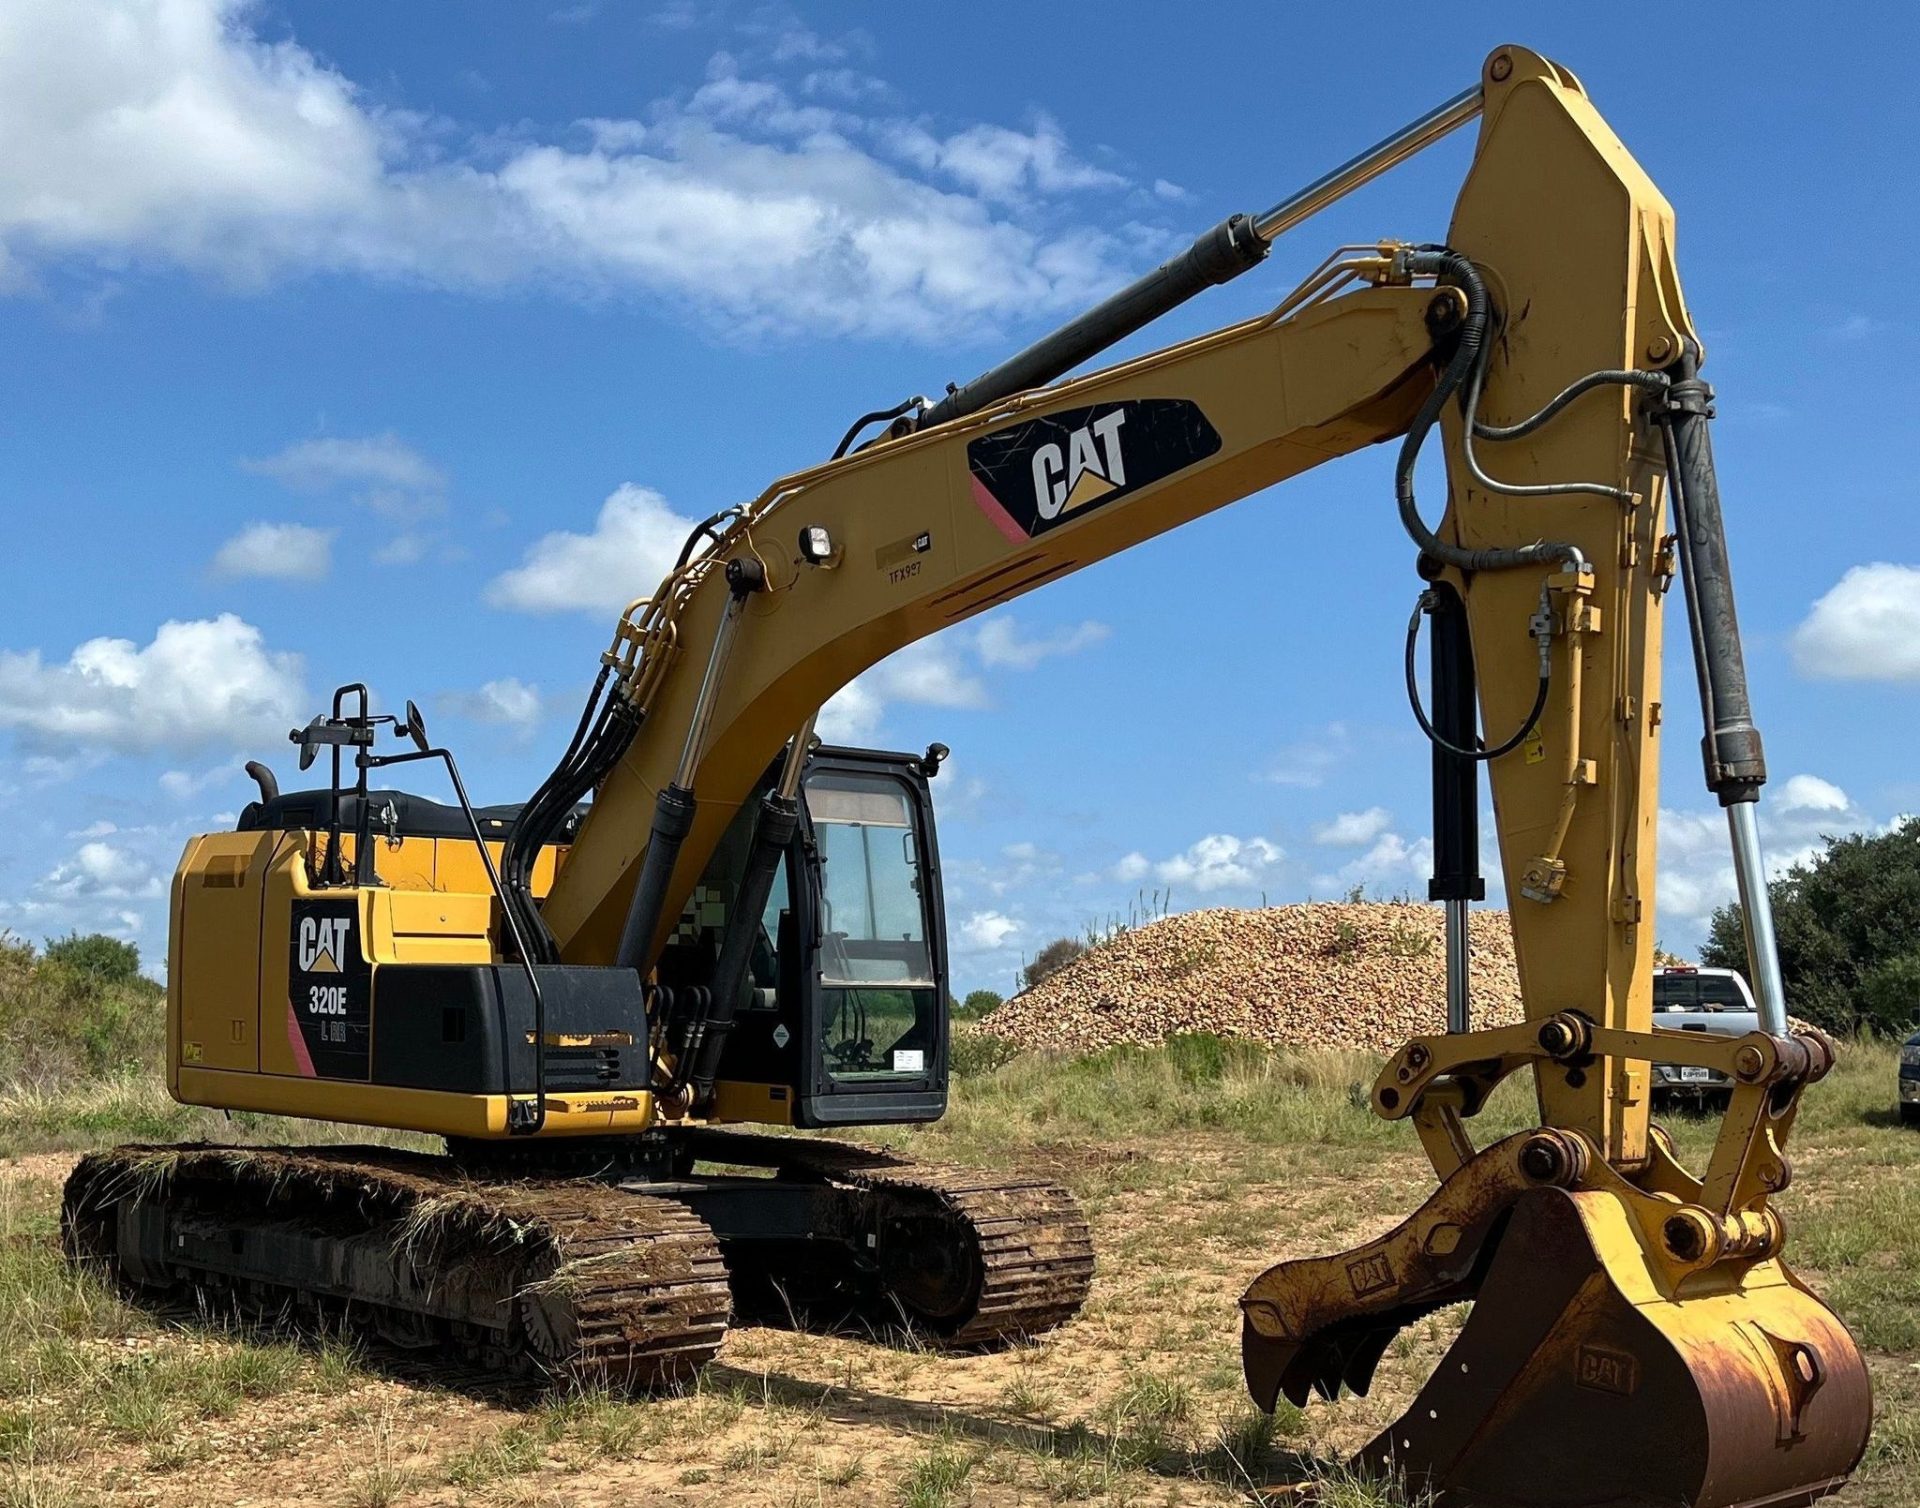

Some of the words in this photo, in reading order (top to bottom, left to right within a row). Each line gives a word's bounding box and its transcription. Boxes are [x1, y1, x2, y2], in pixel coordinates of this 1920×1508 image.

[1031, 407, 1126, 520] CAT
[917, 535, 929, 548] CAT
[299, 916, 350, 973] CAT
[309, 985, 347, 1015] 320E
[321, 1020, 329, 1041] L
[1349, 1256, 1388, 1292] CAT
[1582, 1353, 1627, 1389] CAT
